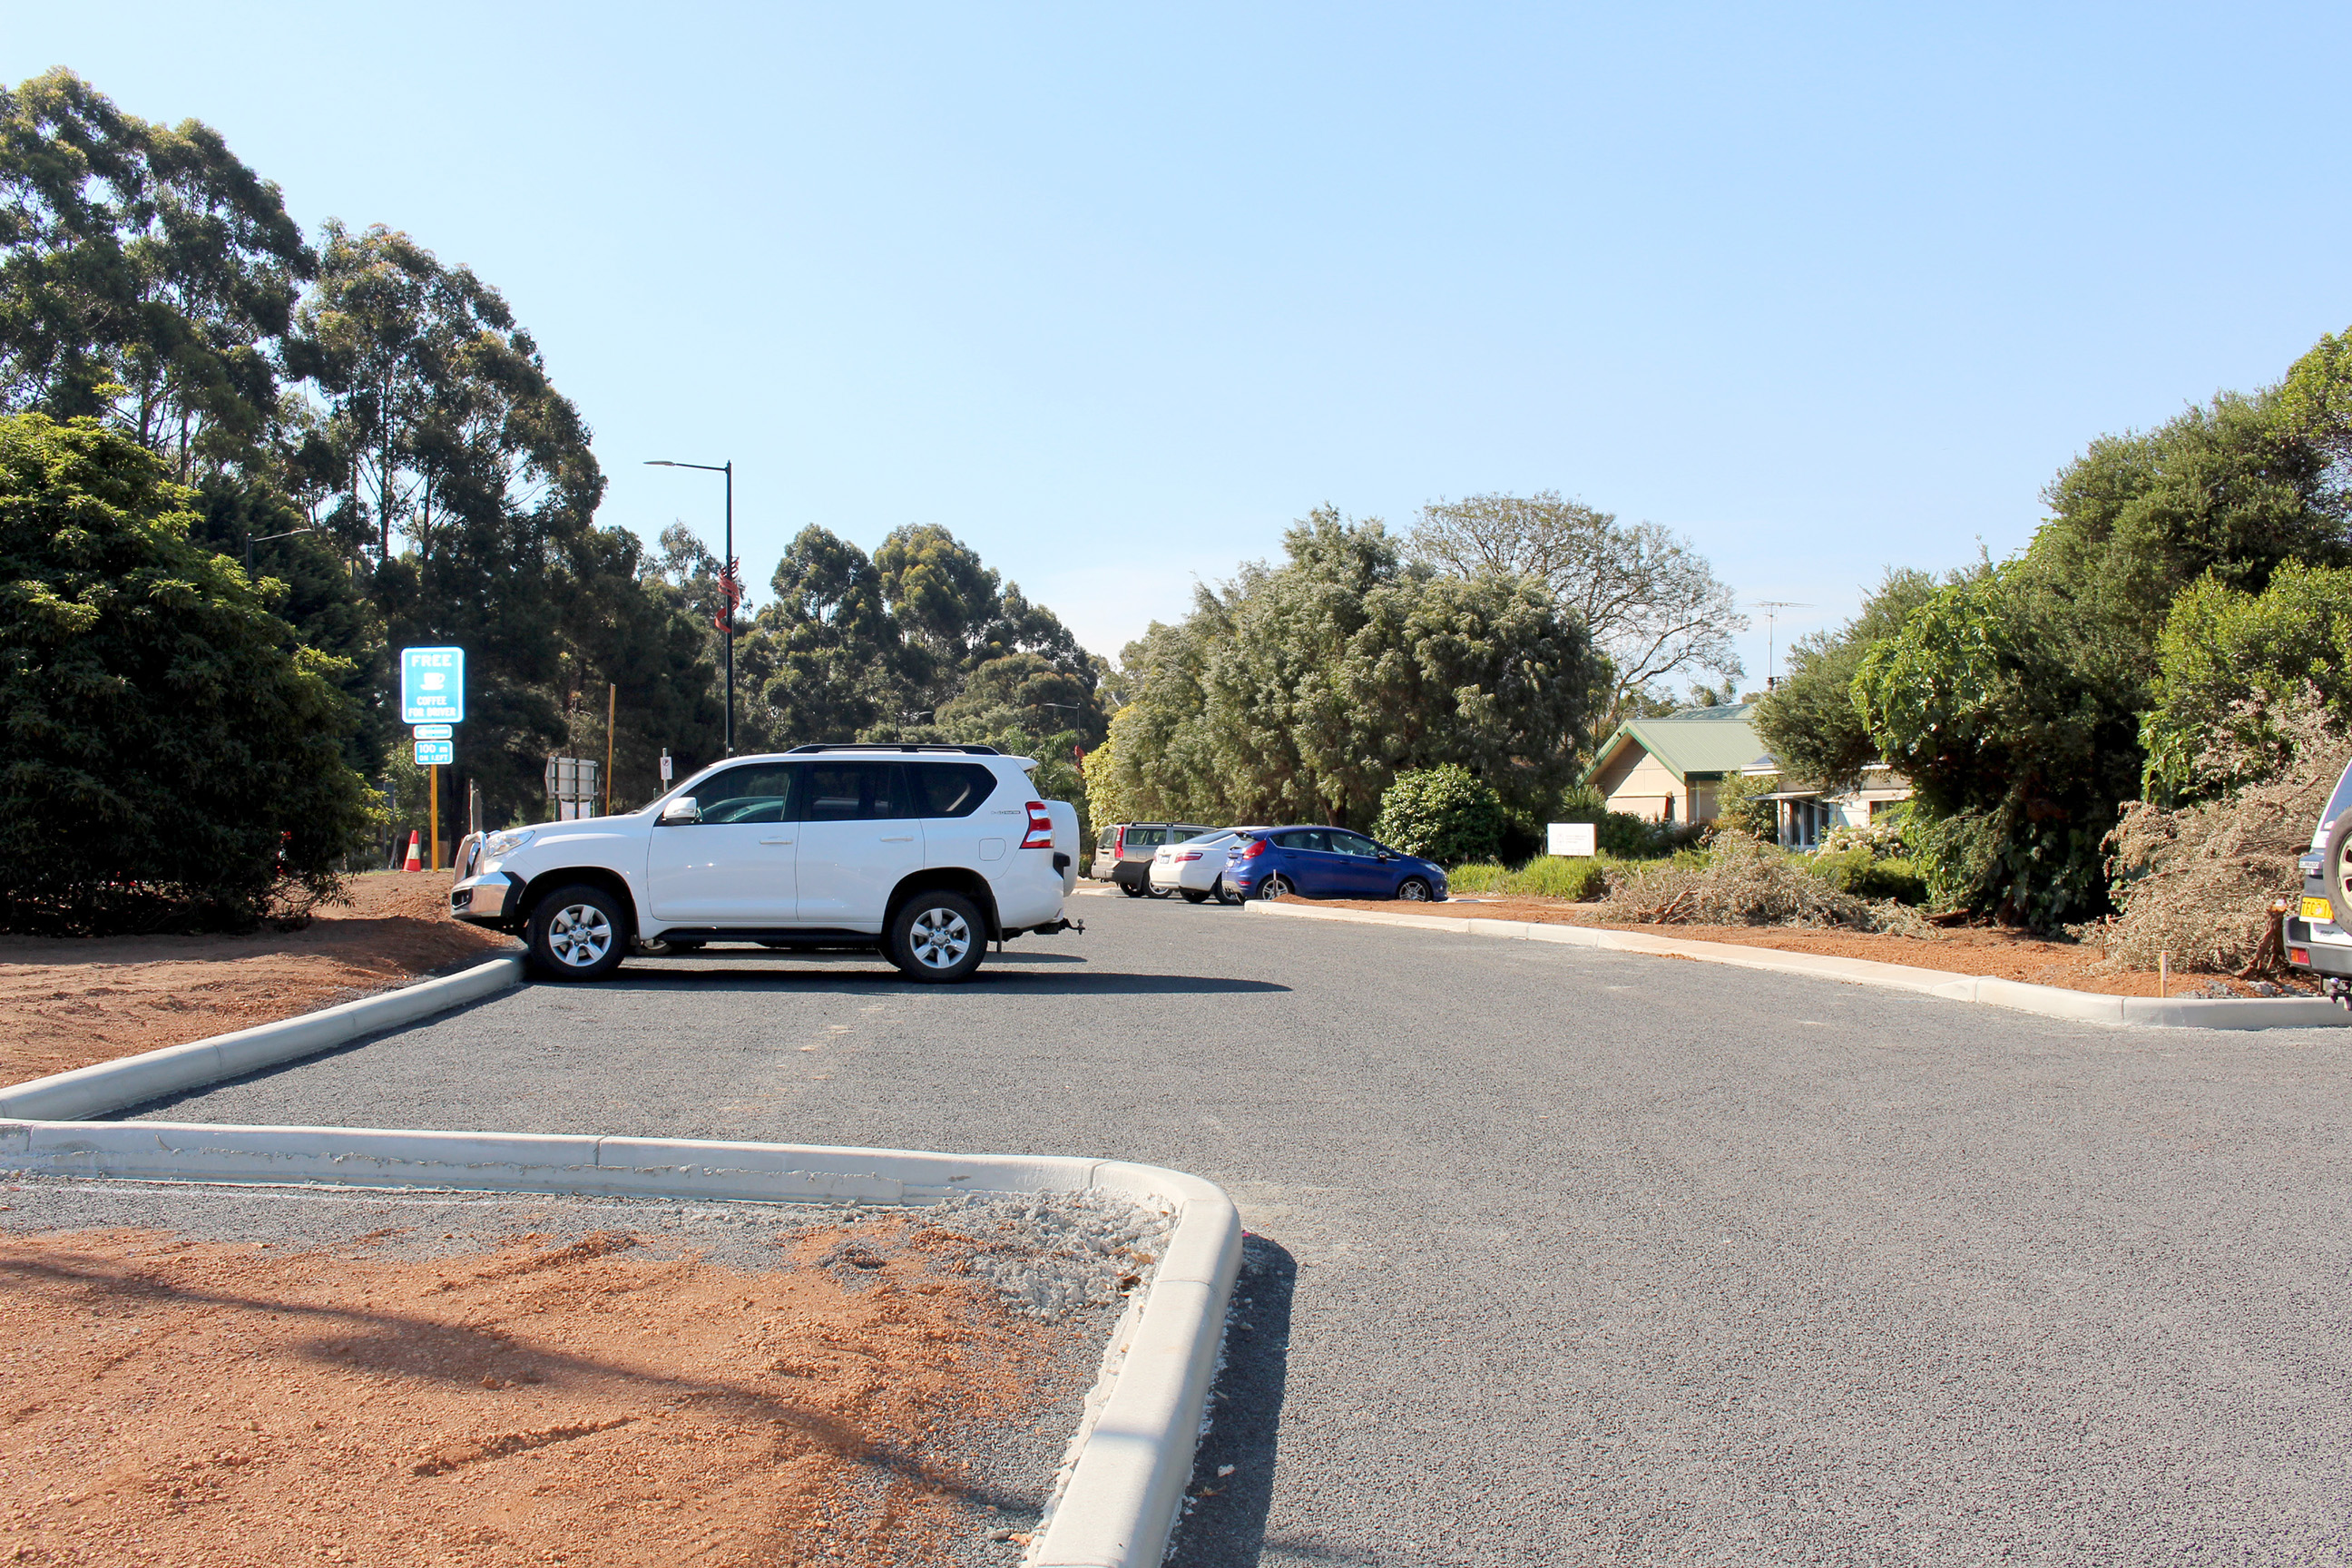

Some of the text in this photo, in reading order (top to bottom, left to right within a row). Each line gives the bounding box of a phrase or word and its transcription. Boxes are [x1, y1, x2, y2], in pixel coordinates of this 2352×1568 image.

[412, 654, 452, 667] FREE
[416, 696, 446, 705] COFFEE
[408, 707, 456, 717] FOR DRIVER
[418, 744, 436, 753] 100
